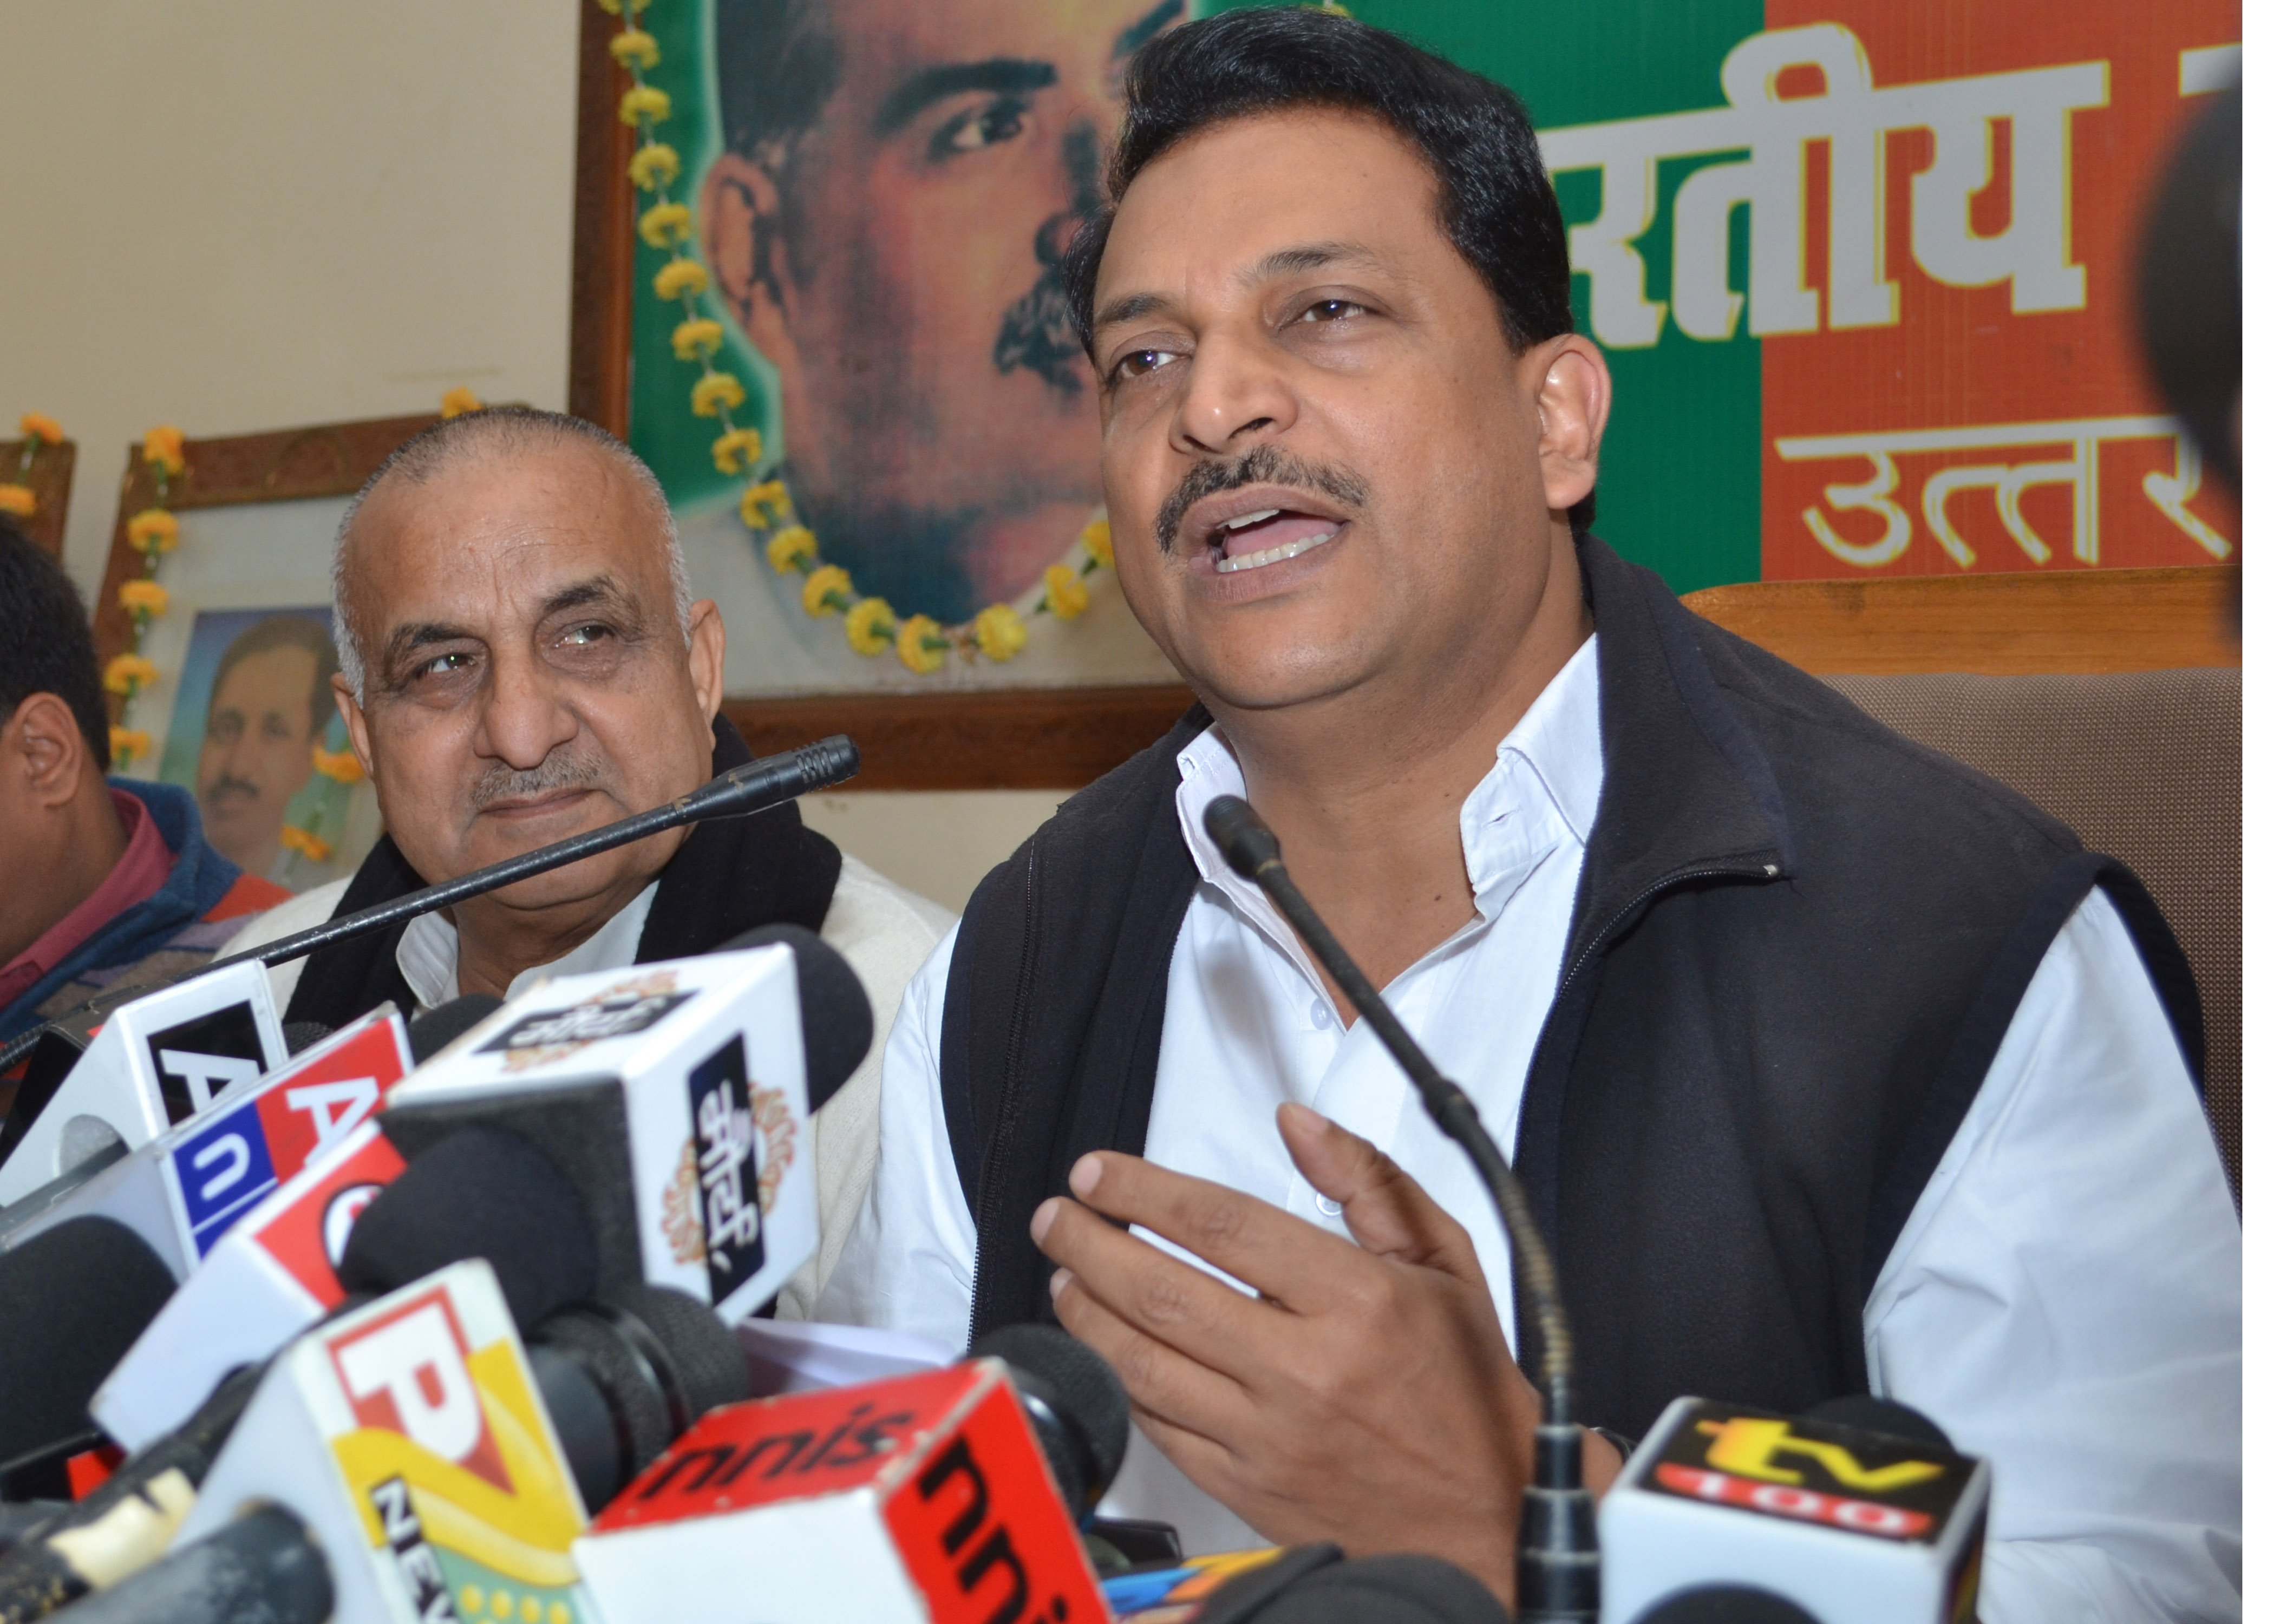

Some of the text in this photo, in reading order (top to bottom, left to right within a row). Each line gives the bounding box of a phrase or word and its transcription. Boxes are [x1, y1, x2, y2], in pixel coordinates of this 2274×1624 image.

[1535, 22, 2110, 351] रतीय
[638, 1403, 915, 1499] nnis
[1695, 1416, 1946, 1493] tv
[918, 1432, 1069, 1624] nn
[1680, 1468, 1906, 1532] 100
